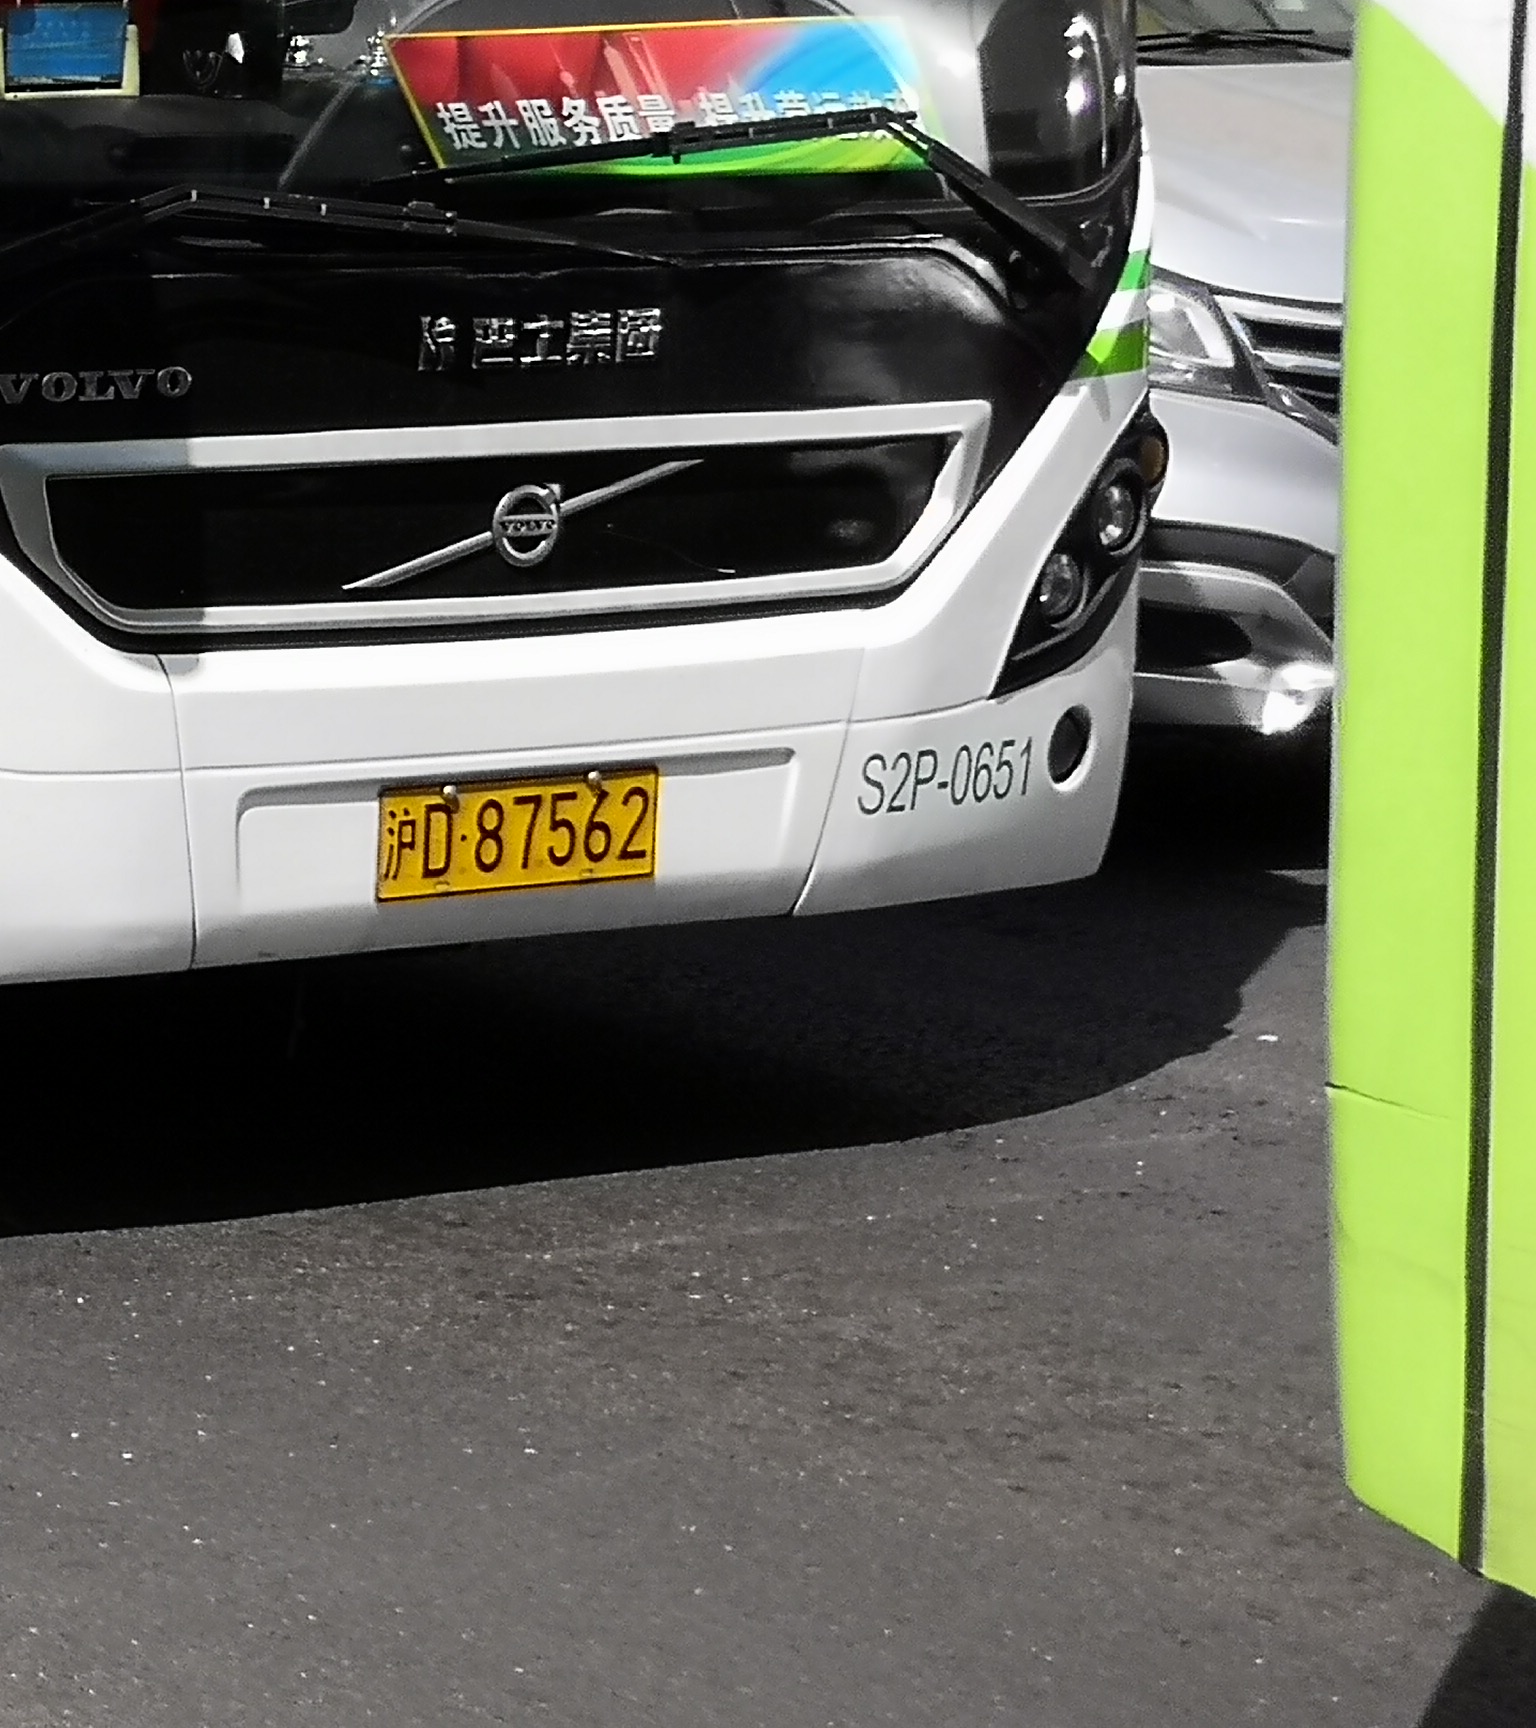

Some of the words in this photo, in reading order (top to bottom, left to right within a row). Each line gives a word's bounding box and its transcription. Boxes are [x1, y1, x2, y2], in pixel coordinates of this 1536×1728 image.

[436, 94, 676, 150] 提升服务质量
[502, 518, 555, 535] VOLVO
[857, 736, 1033, 816] S2P-0651
